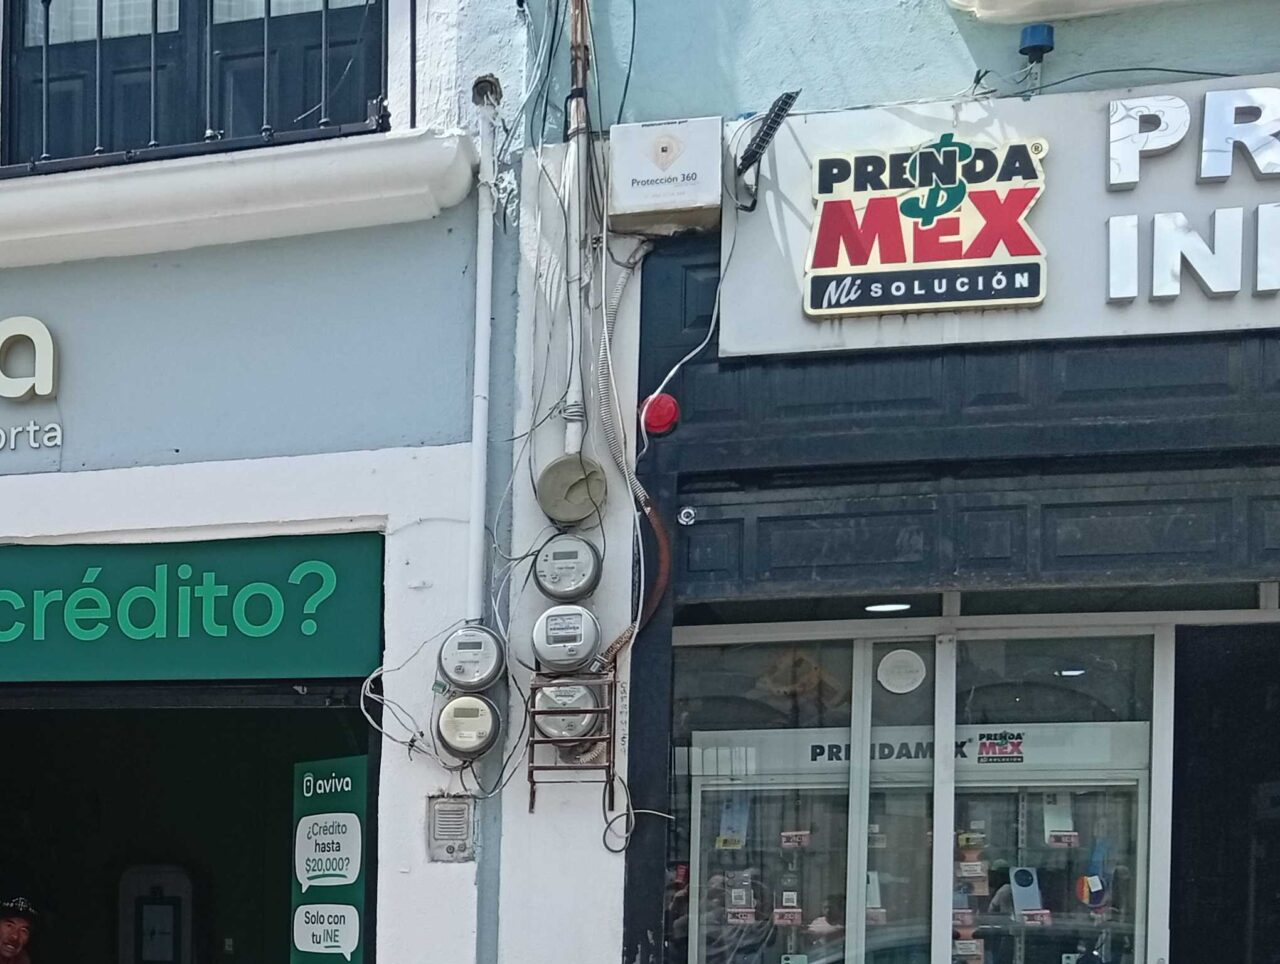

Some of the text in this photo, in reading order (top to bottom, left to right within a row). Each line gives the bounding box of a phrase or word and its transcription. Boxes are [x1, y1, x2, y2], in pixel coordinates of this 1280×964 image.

[818, 143, 1038, 194] PRENDA
[631, 172, 697, 187] Protección 360
[812, 187, 1041, 269] MEX
[822, 271, 1030, 308] Mi SOLUCIÓN
[978, 741, 1023, 755] MEX
[316, 772, 352, 793] aviva
[306, 822, 348, 840] ¿Crédito
[314, 839, 341, 853] hasta
[305, 857, 350, 875] $20,000?
[304, 911, 346, 925] Solo con
[312, 929, 340, 944] tu INE
